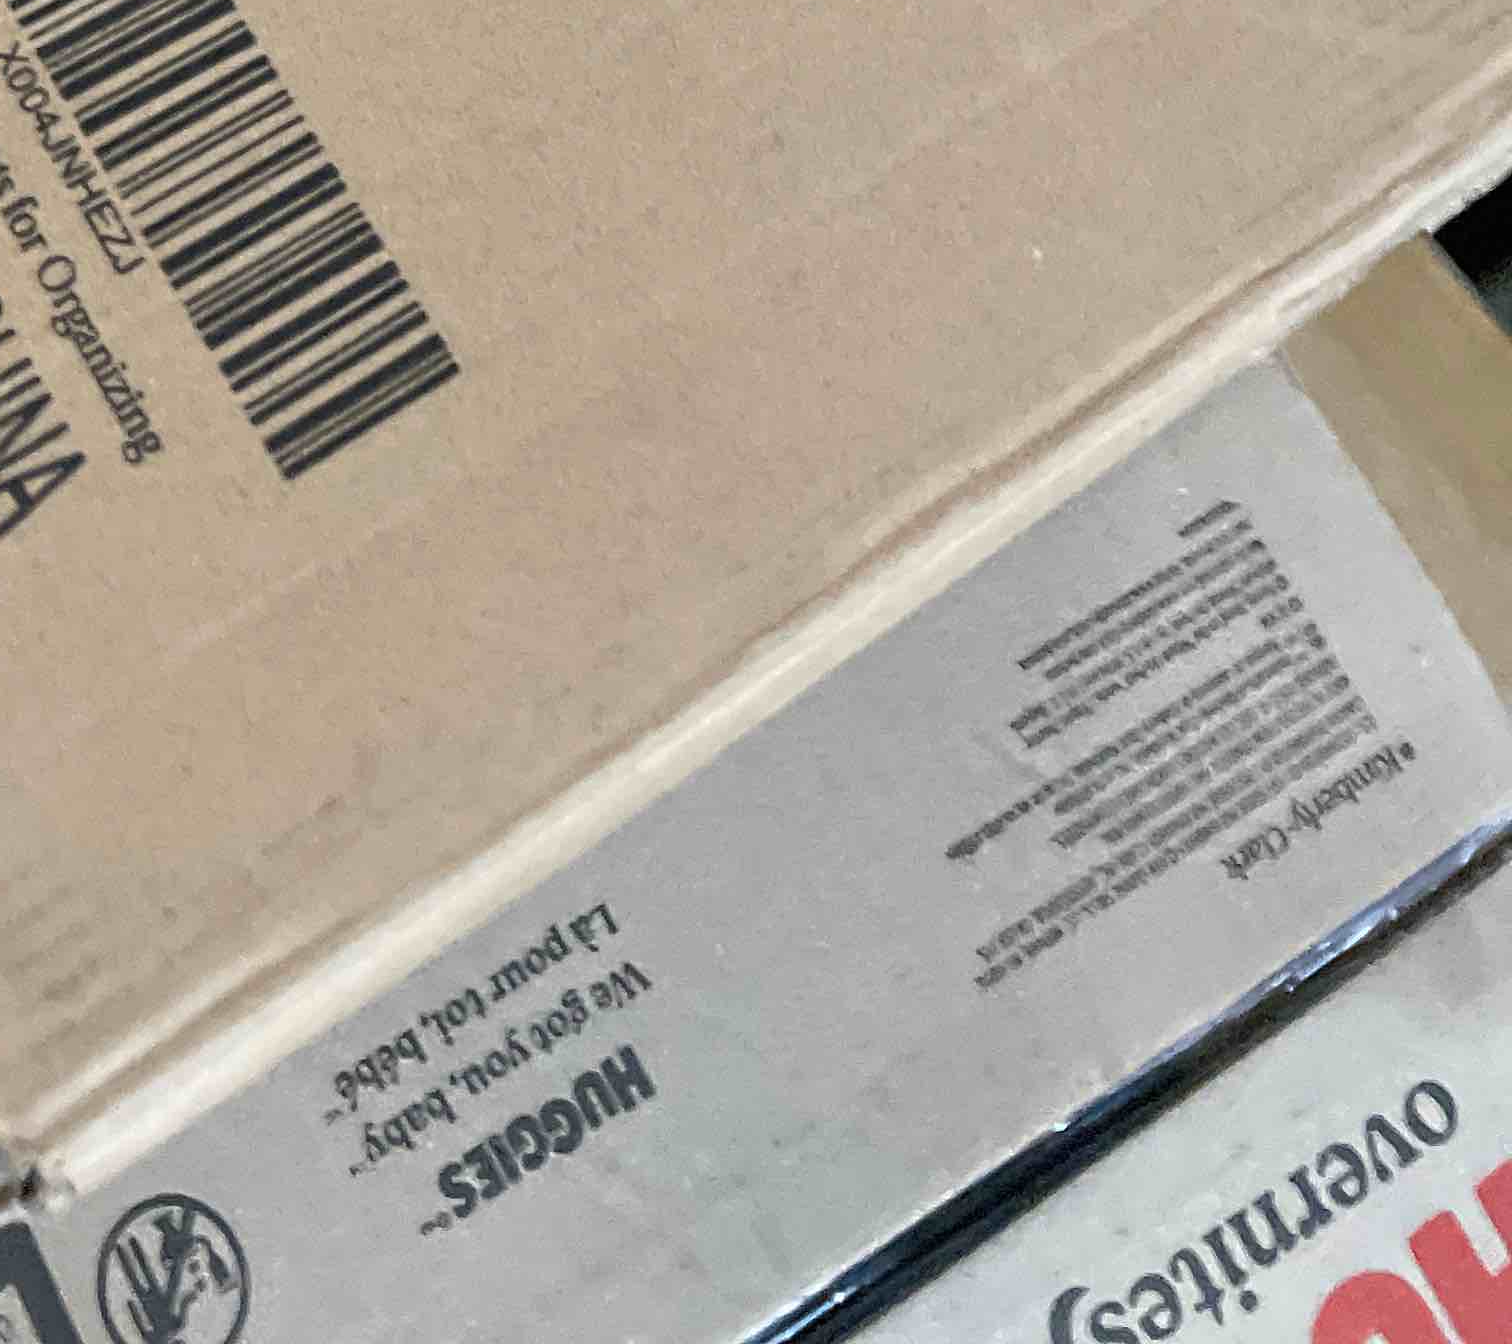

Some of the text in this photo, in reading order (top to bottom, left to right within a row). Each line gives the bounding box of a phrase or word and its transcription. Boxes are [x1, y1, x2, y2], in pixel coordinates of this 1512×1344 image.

[0, 195, 50, 254] for
[35, 254, 163, 466] Organizing
[568, 903, 620, 953] Là
[490, 924, 573, 1003] pour
[588, 962, 653, 1010] We
[419, 987, 487, 1047] toi,
[529, 988, 589, 1054] got
[448, 1027, 533, 1096] you,
[438, 1043, 657, 1219] HUGGIES
